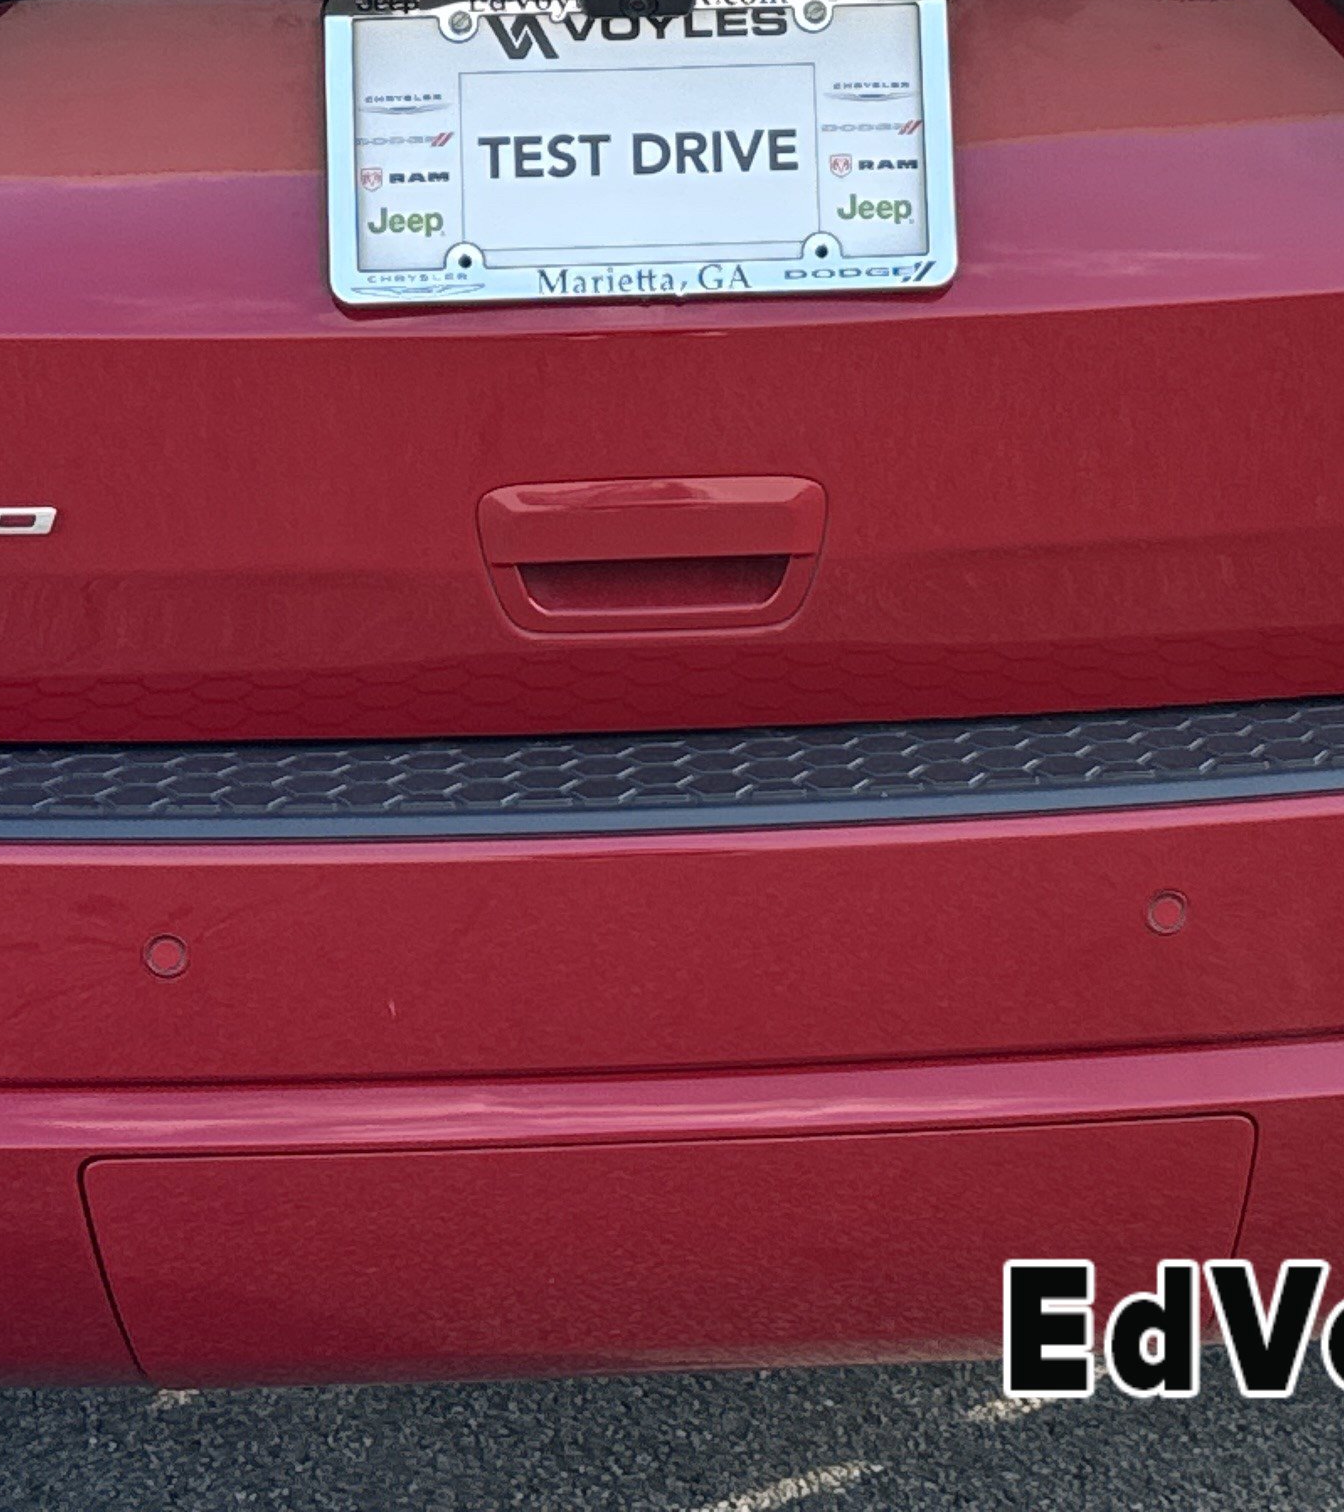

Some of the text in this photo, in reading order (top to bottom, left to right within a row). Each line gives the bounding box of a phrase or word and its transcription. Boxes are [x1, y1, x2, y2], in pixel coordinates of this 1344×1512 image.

[564, 7, 789, 42] VOYLES
[478, 129, 799, 179] TEST DRIVE
[858, 159, 919, 171] RAM
[389, 171, 450, 184] RAM
[367, 207, 444, 238] Jeep
[836, 193, 913, 225] Jeep
[537, 264, 752, 295] Marietta, GA
